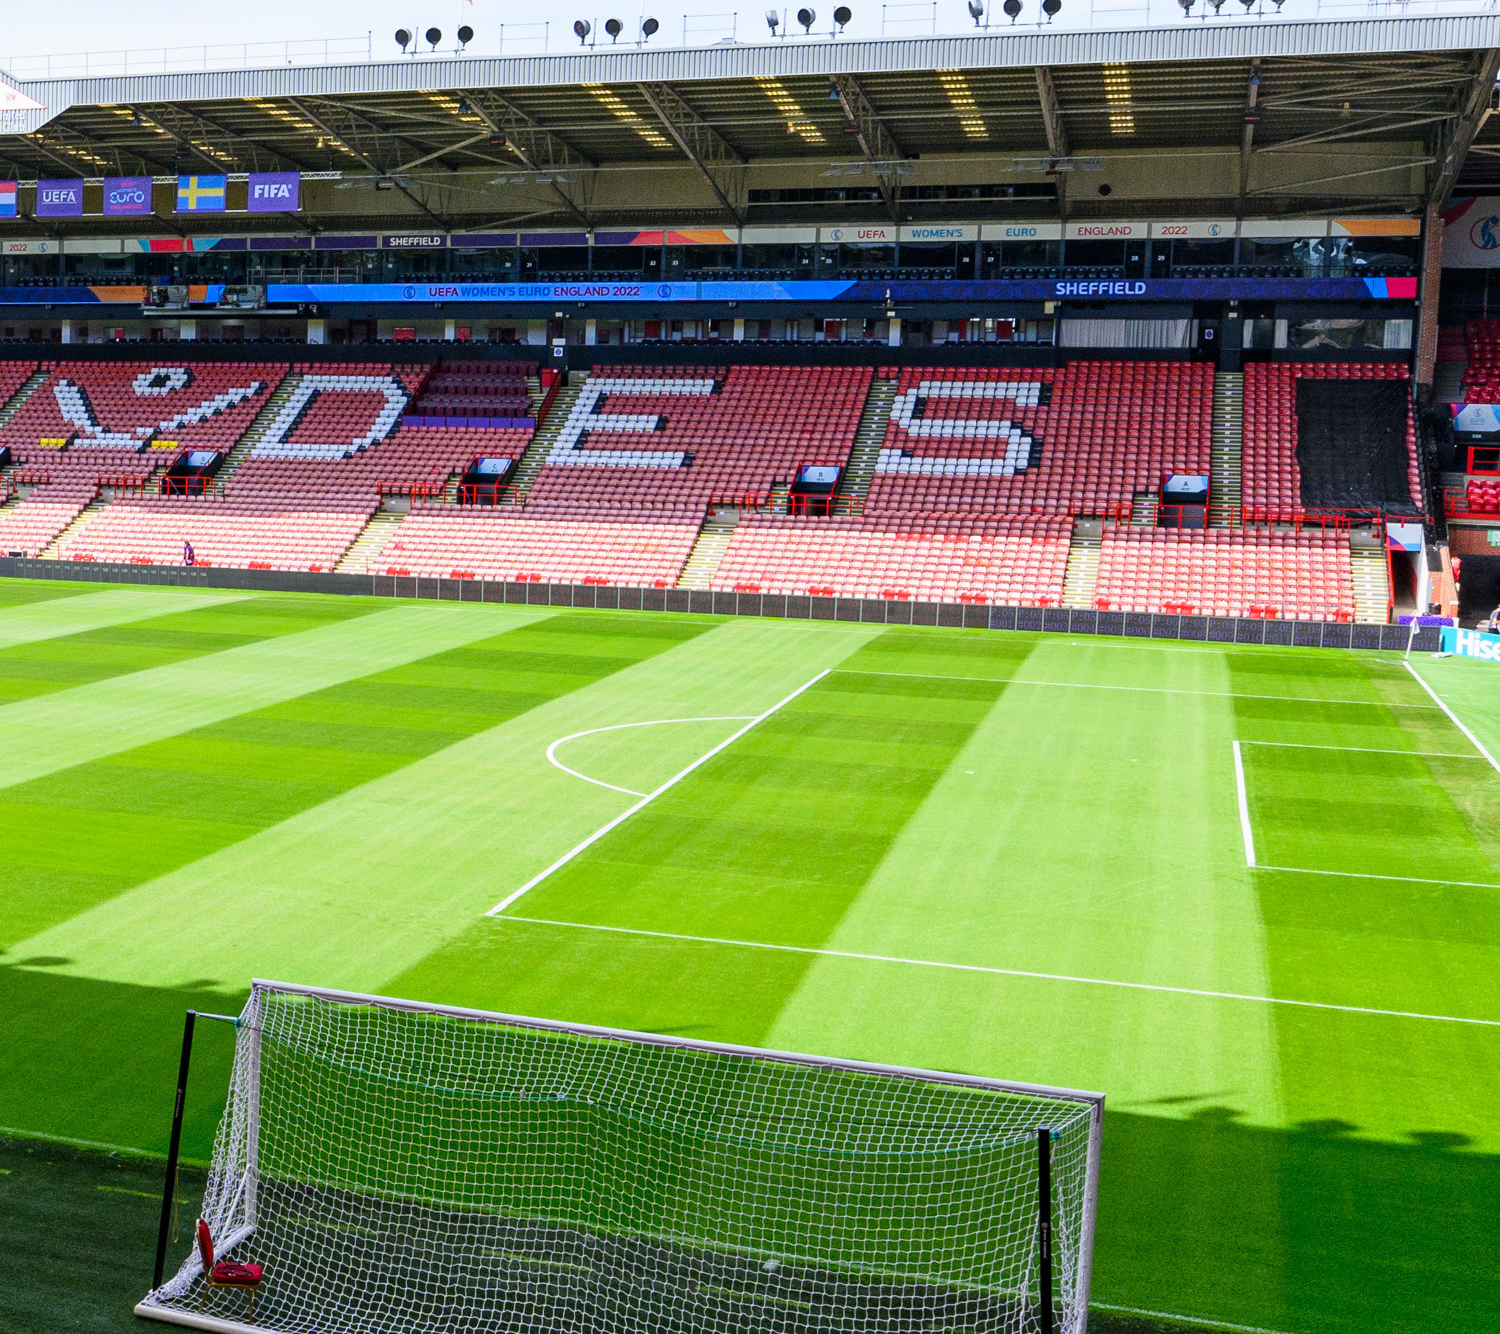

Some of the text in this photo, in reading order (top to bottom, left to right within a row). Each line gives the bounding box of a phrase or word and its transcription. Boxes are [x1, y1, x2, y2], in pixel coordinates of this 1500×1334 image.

[43, 192, 76, 203] UEFA
[857, 225, 1188, 239] UEFA WOMEN'S EURO ENGLAND 2022
[389, 236, 441, 246] SHEFFIELD
[429, 285, 640, 297] UEFA WOMEN'S EURO ENGLAND 2022
[1055, 282, 1147, 295] SHEFFIELD
